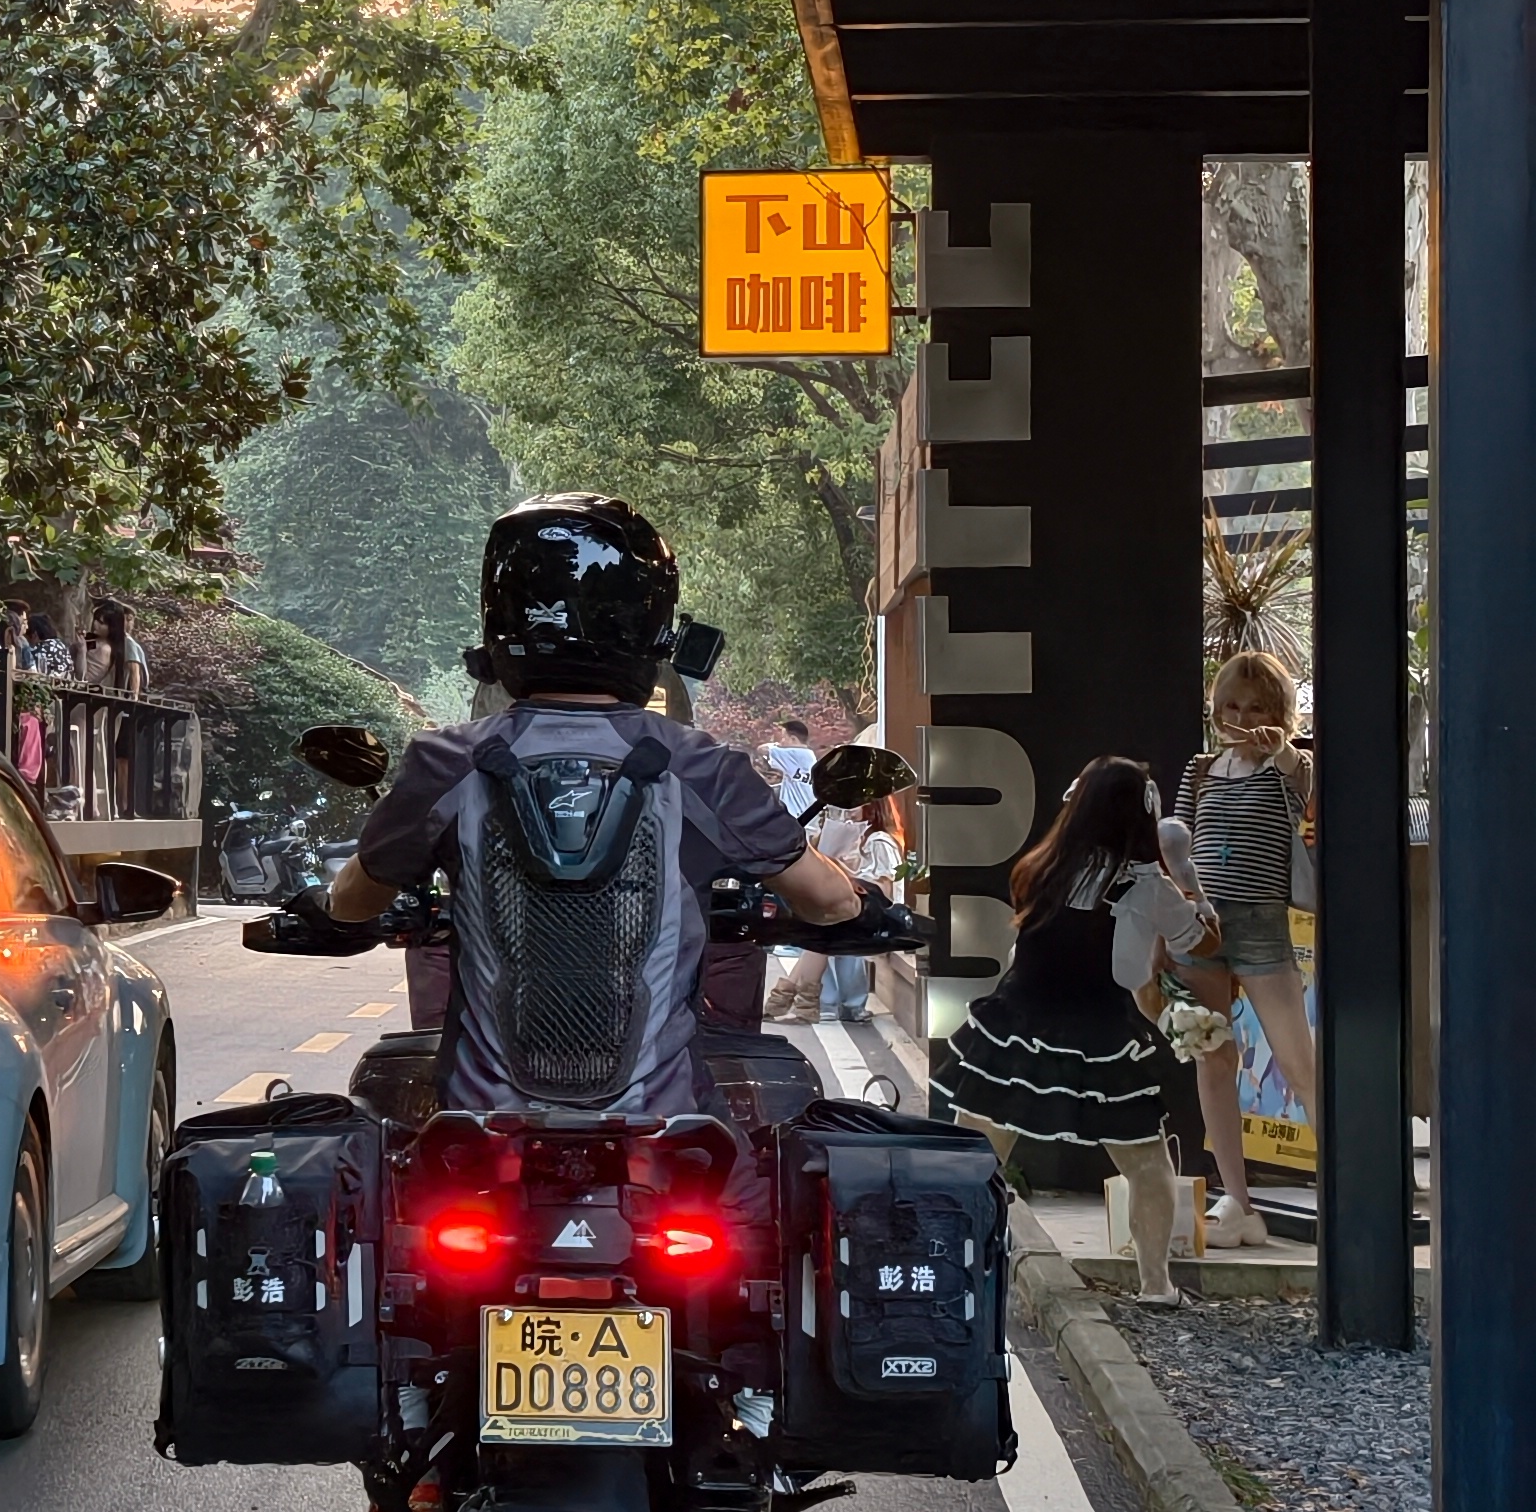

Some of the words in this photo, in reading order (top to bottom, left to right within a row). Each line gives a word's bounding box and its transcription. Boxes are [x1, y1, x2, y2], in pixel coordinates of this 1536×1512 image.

[725, 191, 865, 254] 下山
[726, 271, 867, 334] 咖啡
[792, 767, 813, 786] ba
[232, 1277, 285, 1303] 彭浩
[878, 1265, 936, 1292] 彭浩
